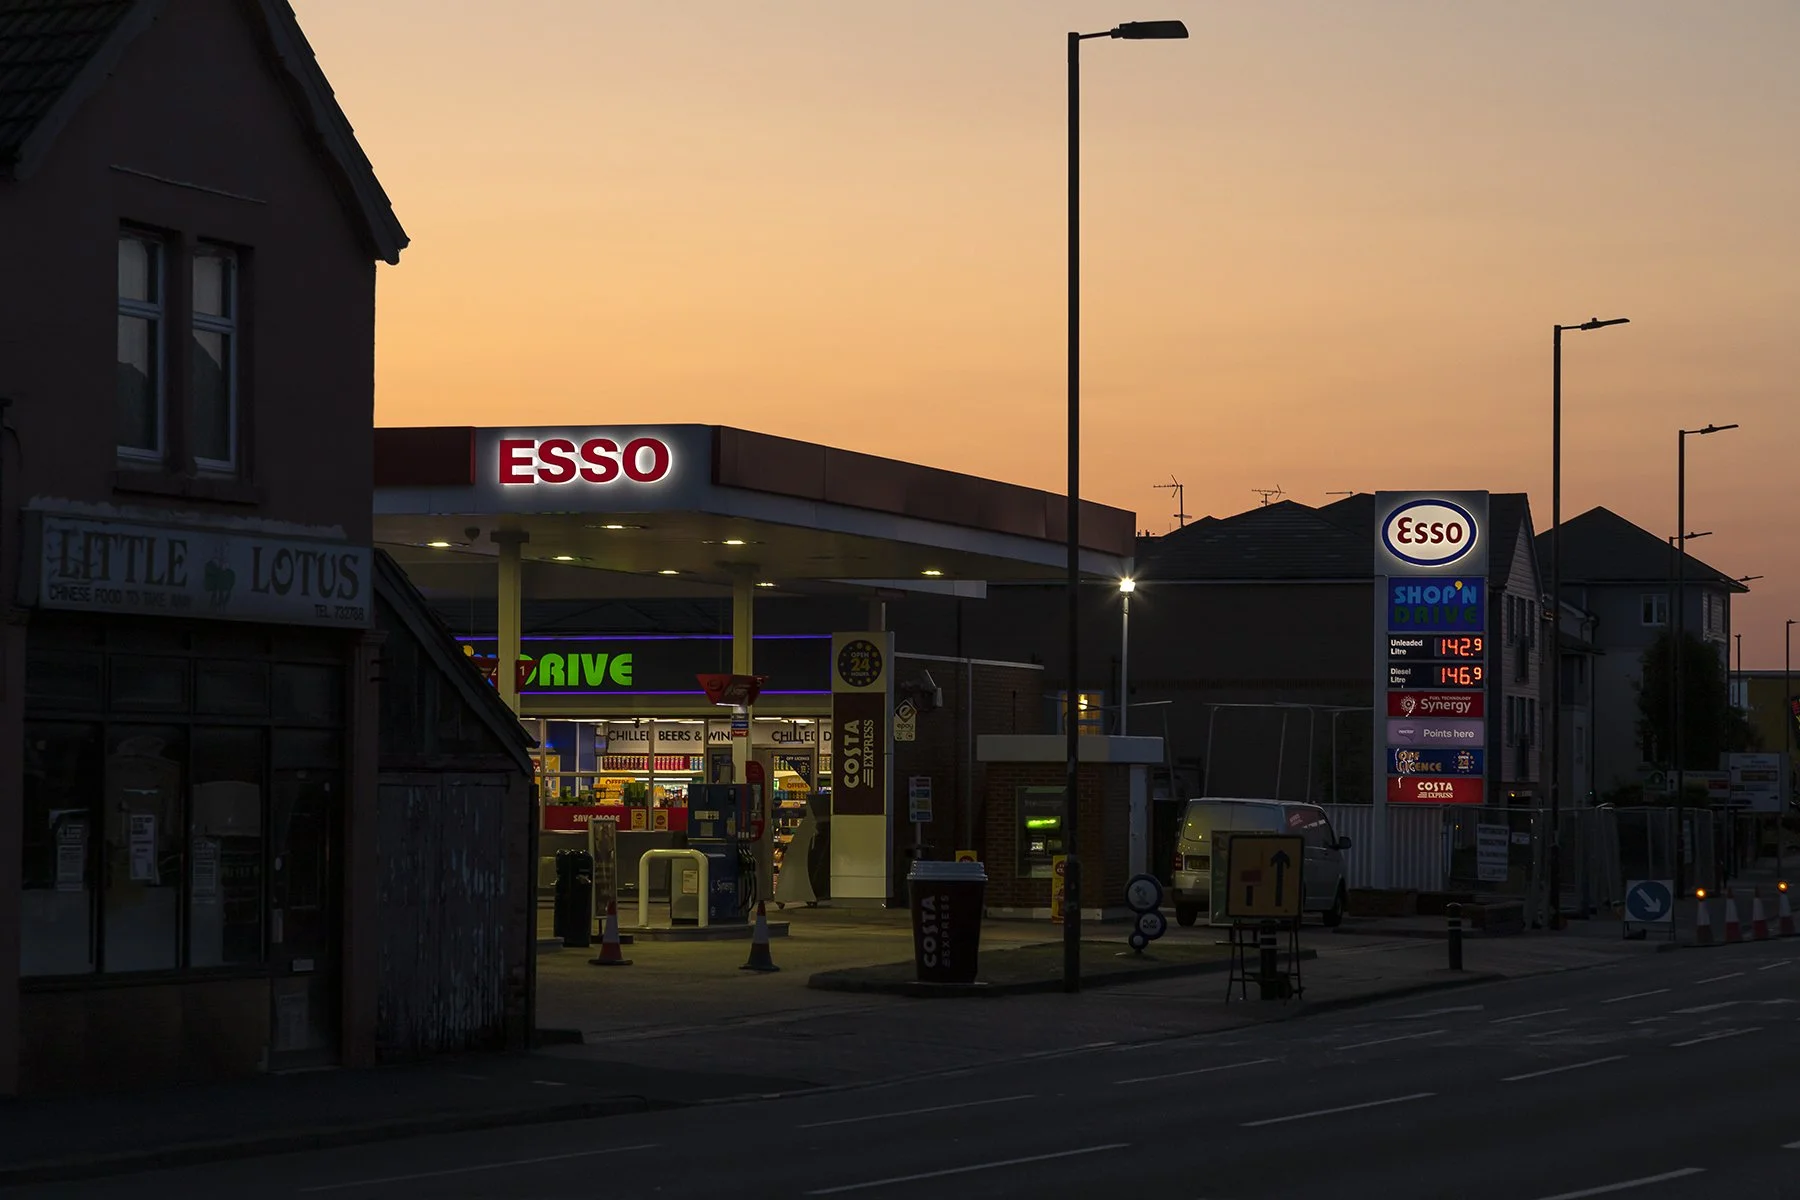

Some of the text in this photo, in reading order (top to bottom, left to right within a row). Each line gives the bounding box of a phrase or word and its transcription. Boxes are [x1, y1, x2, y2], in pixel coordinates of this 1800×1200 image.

[499, 437, 671, 485] ESSO
[1397, 516, 1463, 544] Esso
[47, 528, 359, 600] LITTLE LOTUS
[48, 584, 92, 602] CHINESE
[95, 588, 122, 605] FOOD
[1394, 580, 1477, 604] SHOP'N
[1394, 606, 1477, 624] DRIVE
[1390, 637, 1482, 657] Unleaded 142.9
[519, 665, 525, 676] 1
[851, 658, 871, 672] 24
[1441, 666, 1482, 685] 146.9
[1420, 699, 1472, 714] Synergy
[658, 730, 690, 741] BEERS
[694, 731, 702, 741] &
[708, 731, 733, 741] WIN
[863, 719, 875, 768] EXPRESS
[1423, 729, 1475, 738] Points here
[844, 719, 862, 789] COSTA
[1417, 782, 1454, 791] COSTA
[921, 895, 939, 968] COSTA
[940, 895, 951, 958] EXPRESS
